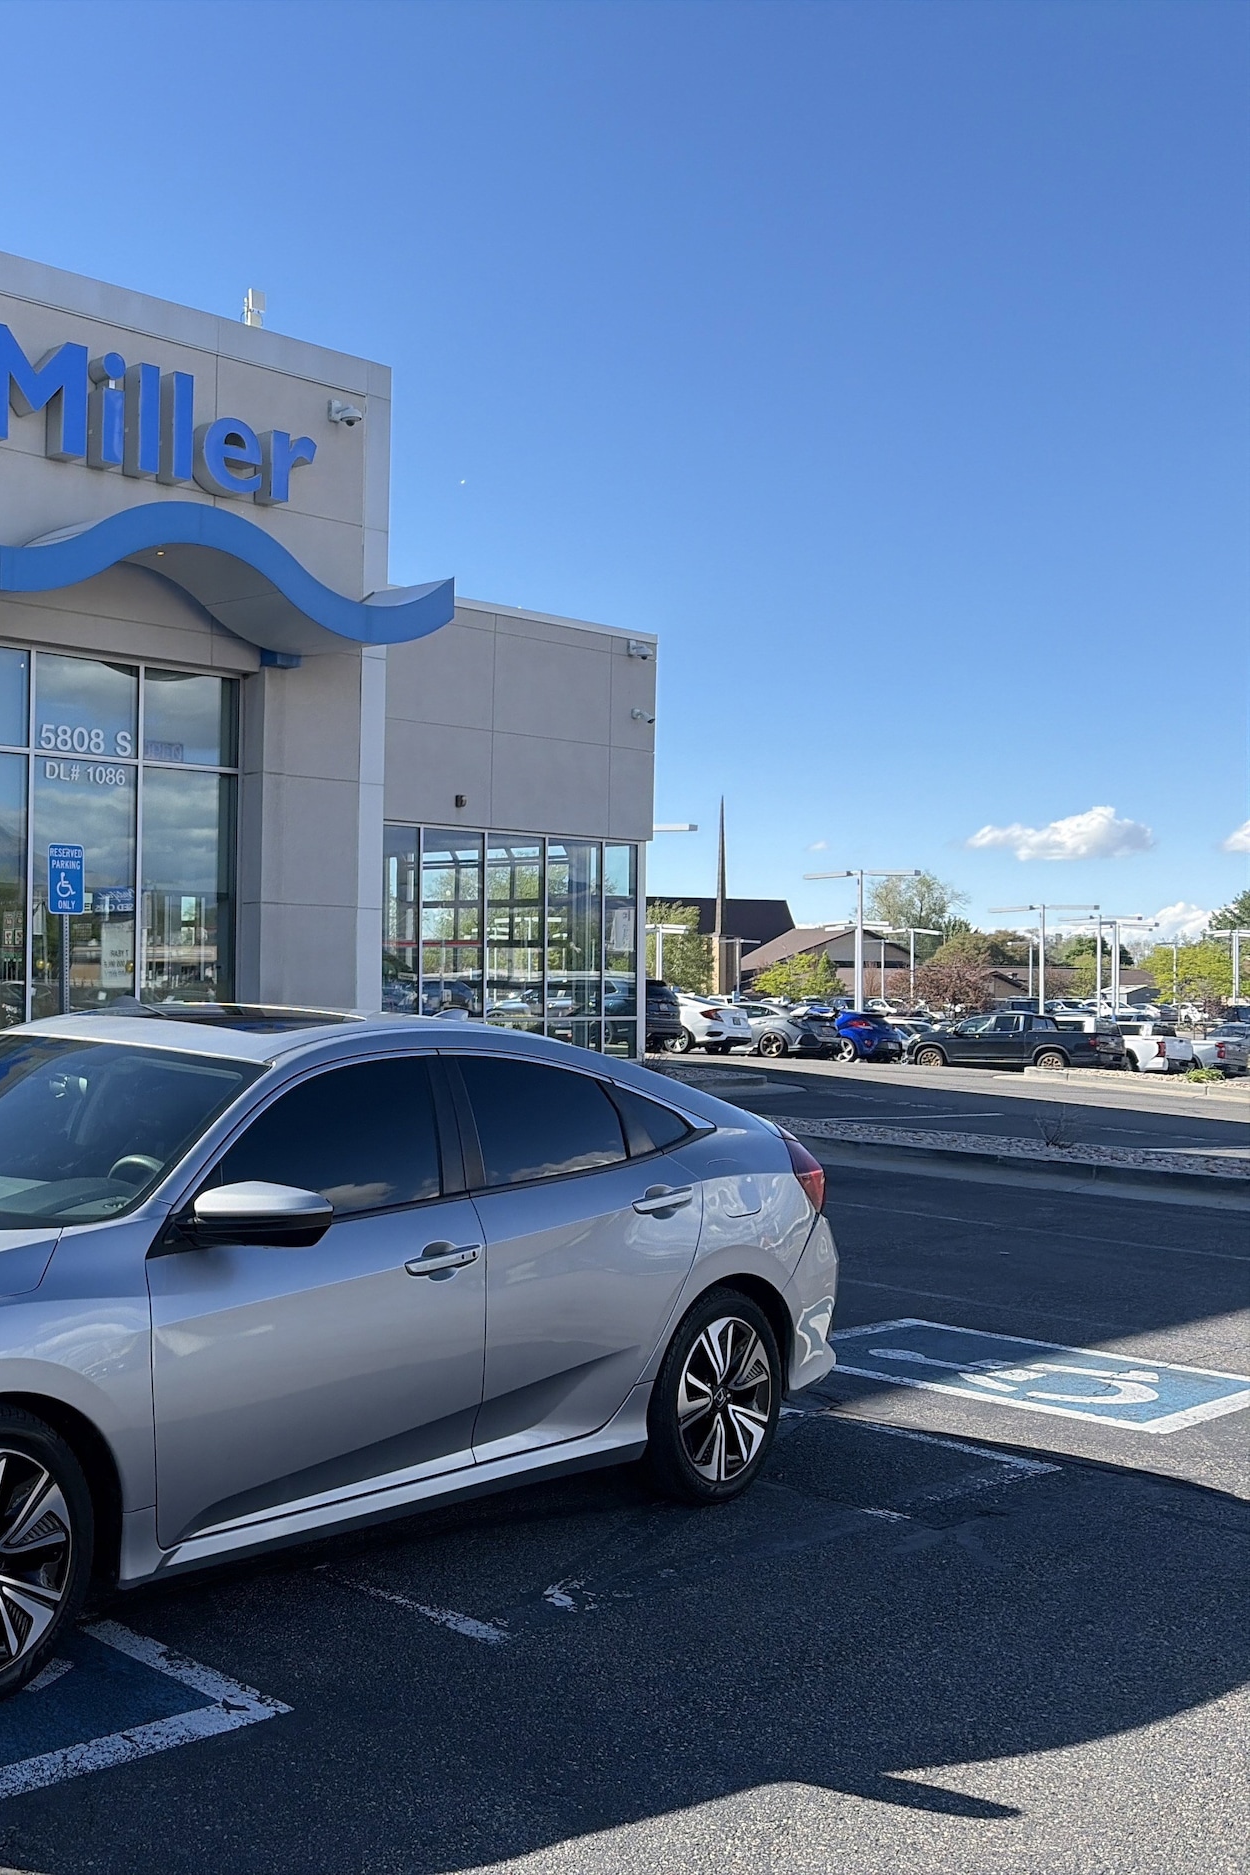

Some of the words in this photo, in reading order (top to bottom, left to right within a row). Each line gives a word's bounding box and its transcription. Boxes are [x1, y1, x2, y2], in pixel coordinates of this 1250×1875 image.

[40, 723, 105, 754] 5808
[115, 730, 132, 757] S
[45, 761, 80, 781] DL#
[86, 766, 126, 786] 1086
[50, 847, 83, 859] RESERVED
[51, 859, 81, 870] PARKING
[57, 899, 76, 910] ONLY
